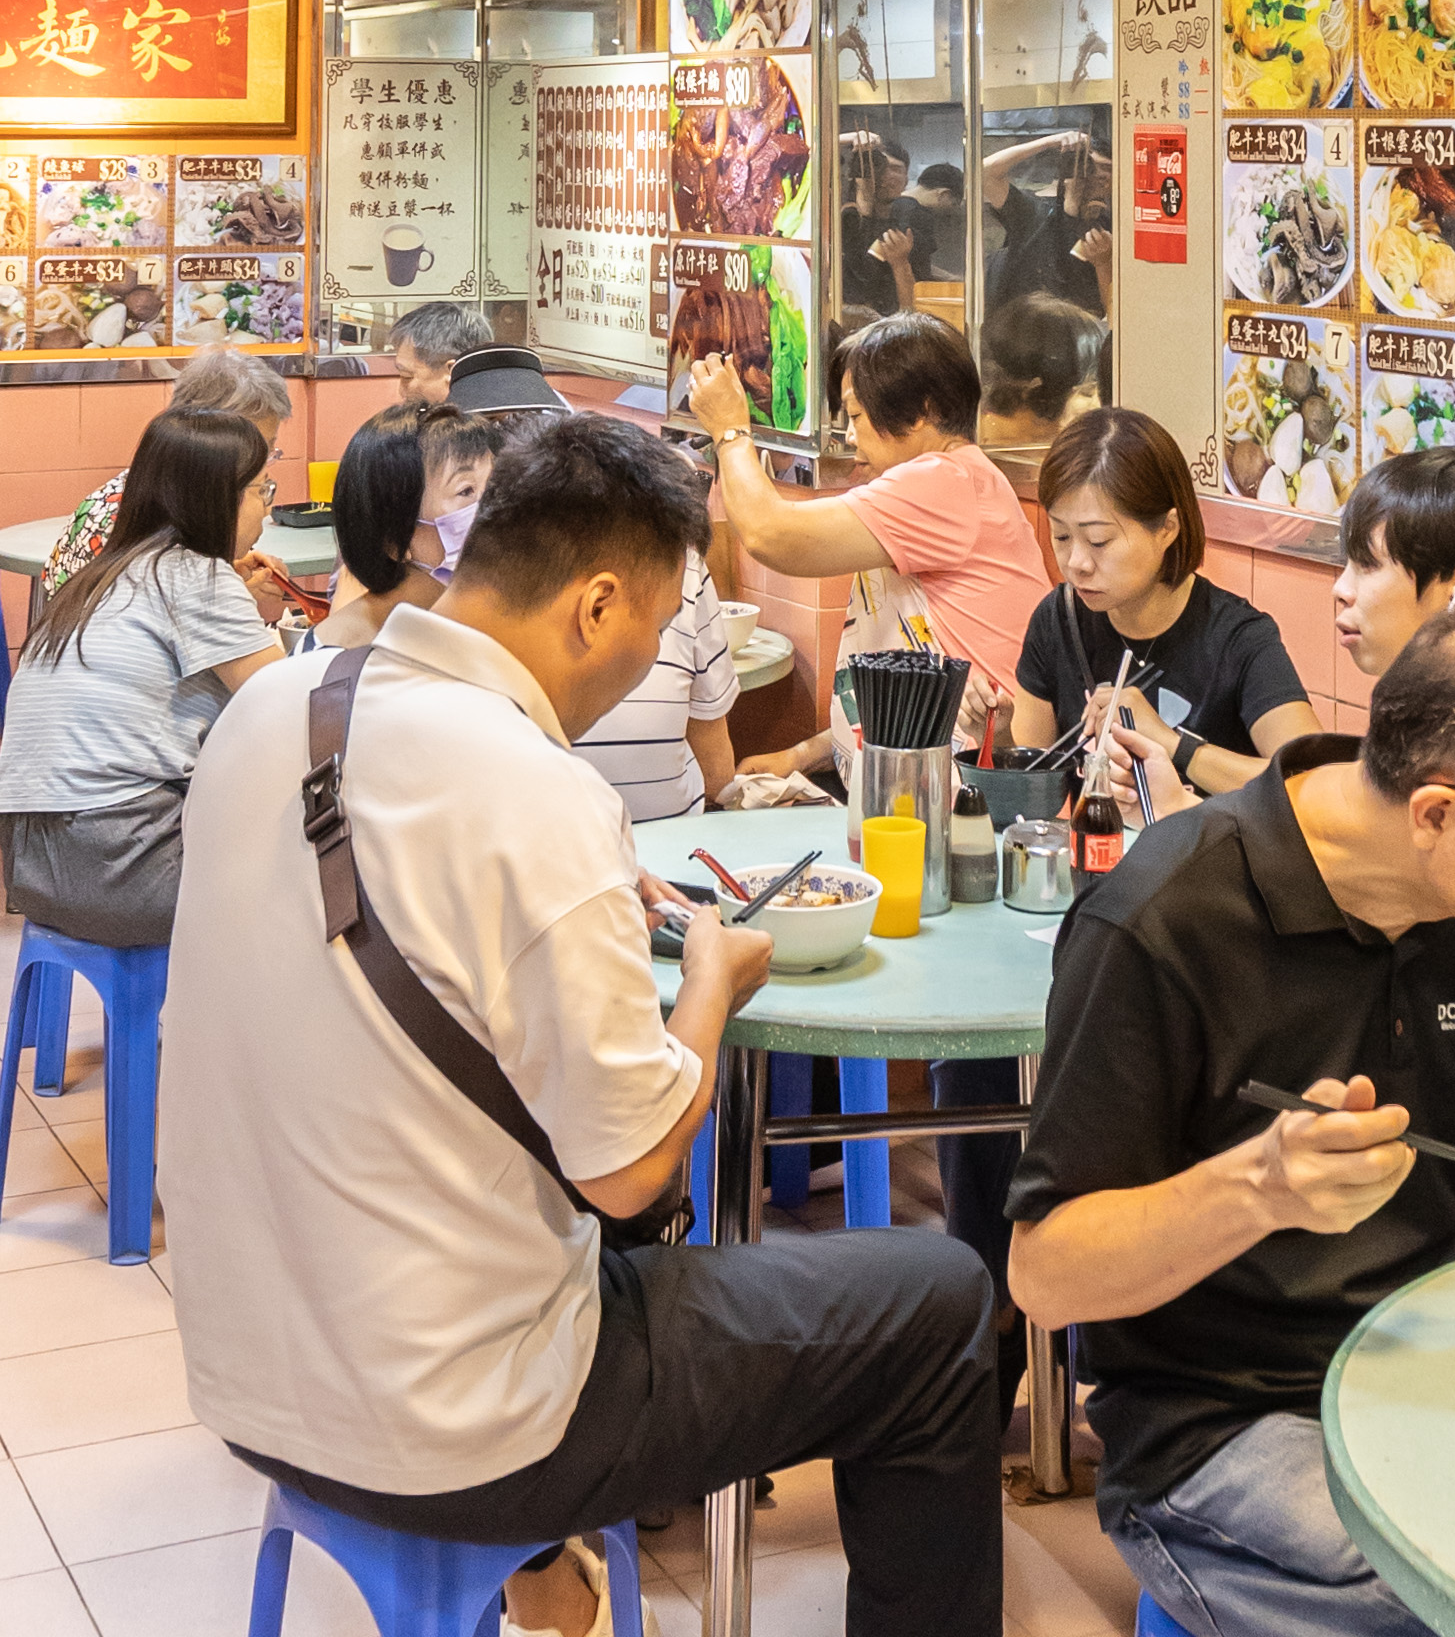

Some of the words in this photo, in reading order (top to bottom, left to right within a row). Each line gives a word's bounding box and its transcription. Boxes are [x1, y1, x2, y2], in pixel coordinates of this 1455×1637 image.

[349, 77, 457, 106] 學生優惠
[724, 66, 750, 108] $80
[1279, 127, 1307, 163] $34
[1329, 132, 1341, 162] 4
[8, 161, 19, 179] 2
[99, 158, 127, 181] $28
[147, 161, 158, 179] 3
[234, 159, 262, 181] $34
[286, 161, 296, 179] 4
[5, 265, 16, 282] 6
[95, 260, 125, 282] $34
[145, 263, 156, 280] 7
[233, 258, 260, 280] $34
[284, 260, 295, 277] 8
[535, 239, 564, 309] 全日
[723, 251, 749, 293] $80
[1280, 321, 1307, 360] $34
[1330, 331, 1343, 360] 7
